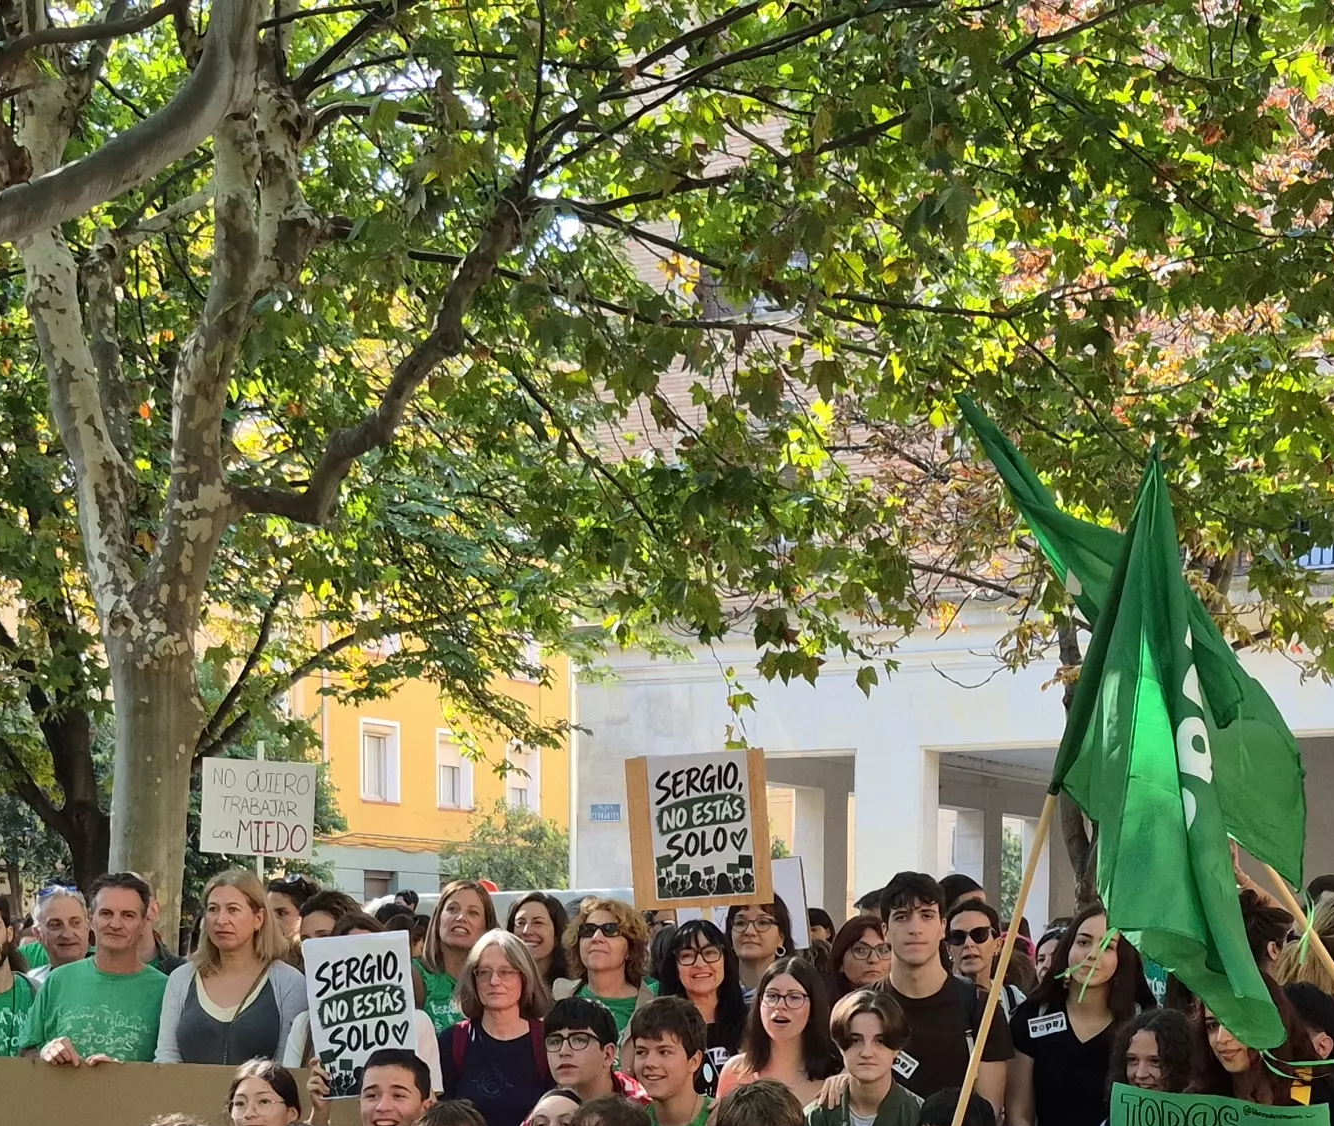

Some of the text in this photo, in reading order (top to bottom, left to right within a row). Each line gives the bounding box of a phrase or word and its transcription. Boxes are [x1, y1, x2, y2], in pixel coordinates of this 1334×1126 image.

[213, 768, 310, 795] NO QUIERO
[655, 761, 743, 805] SERGIO,
[221, 796, 298, 817] TRABAJAR
[662, 795, 743, 831] NO ESTÁS
[212, 819, 308, 853] con MIEDO
[666, 827, 728, 863] SOLO
[315, 950, 403, 998] SERGIO,
[323, 986, 403, 1024] NO ESTÁS
[329, 1020, 389, 1057] SOLO
